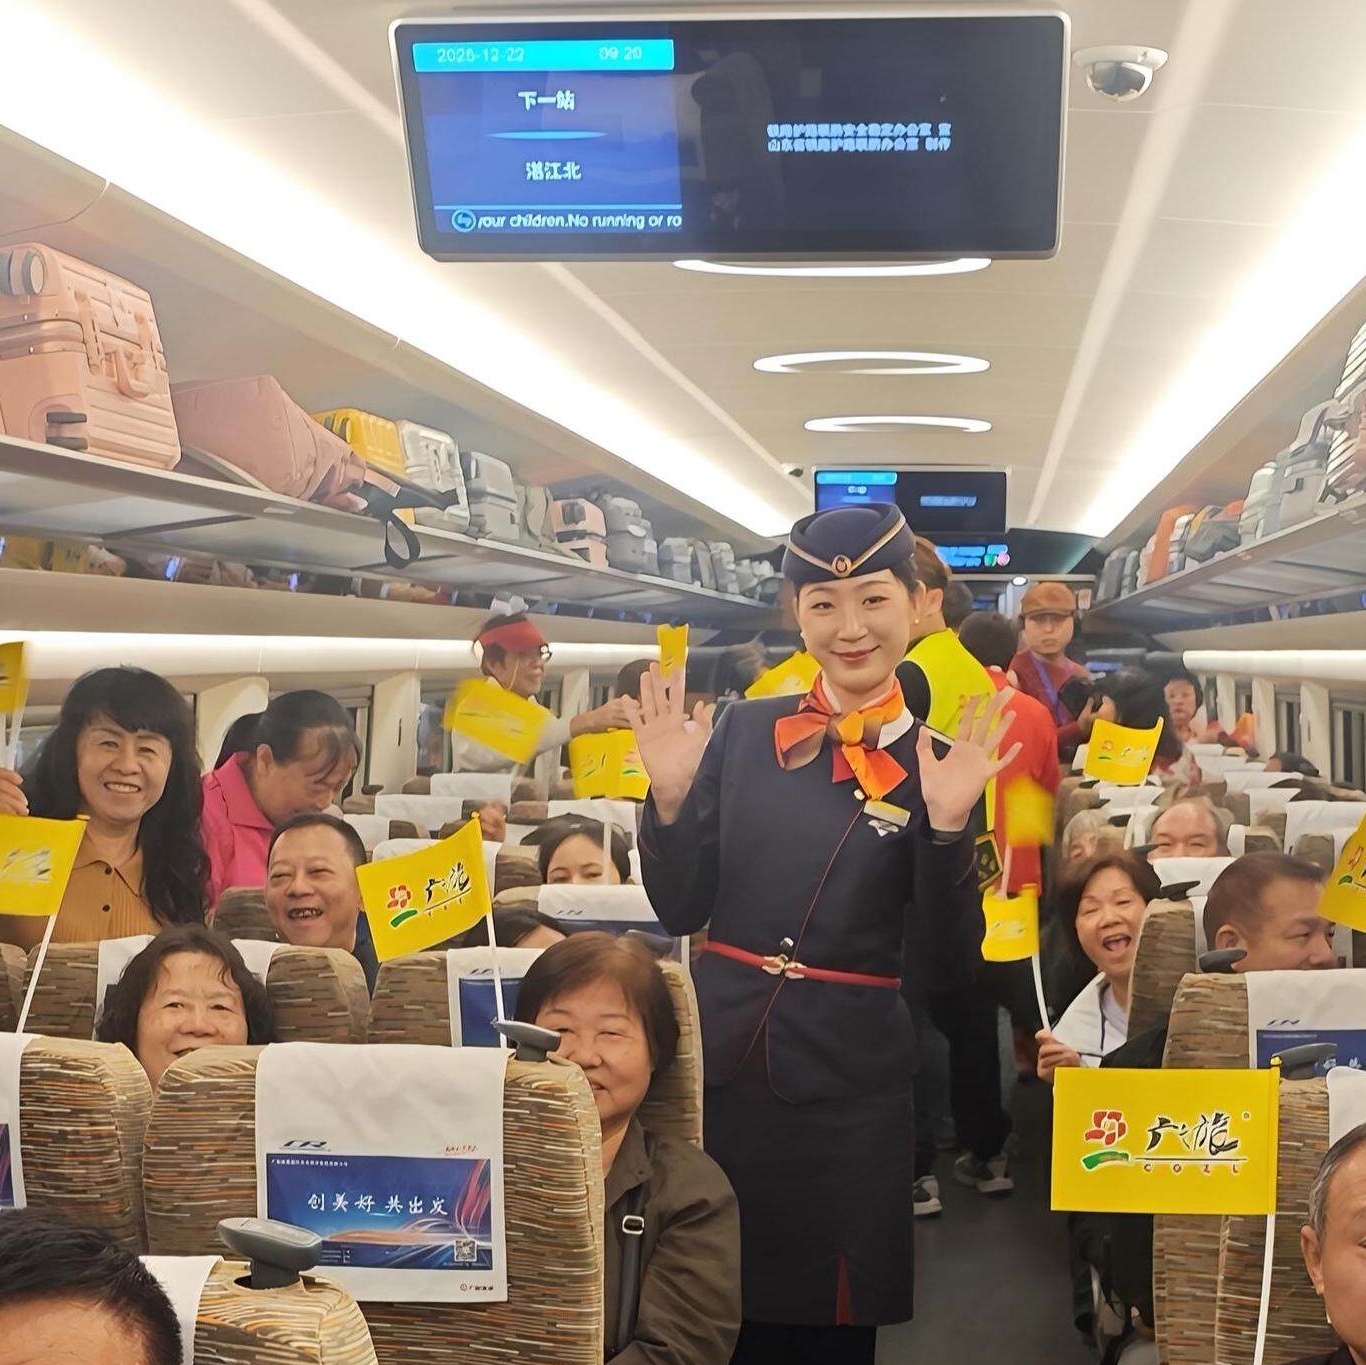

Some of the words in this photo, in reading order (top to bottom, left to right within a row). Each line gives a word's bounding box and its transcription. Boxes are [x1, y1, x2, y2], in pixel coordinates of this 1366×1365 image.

[518, 91, 575, 111] 下一站
[592, 214, 645, 230] running
